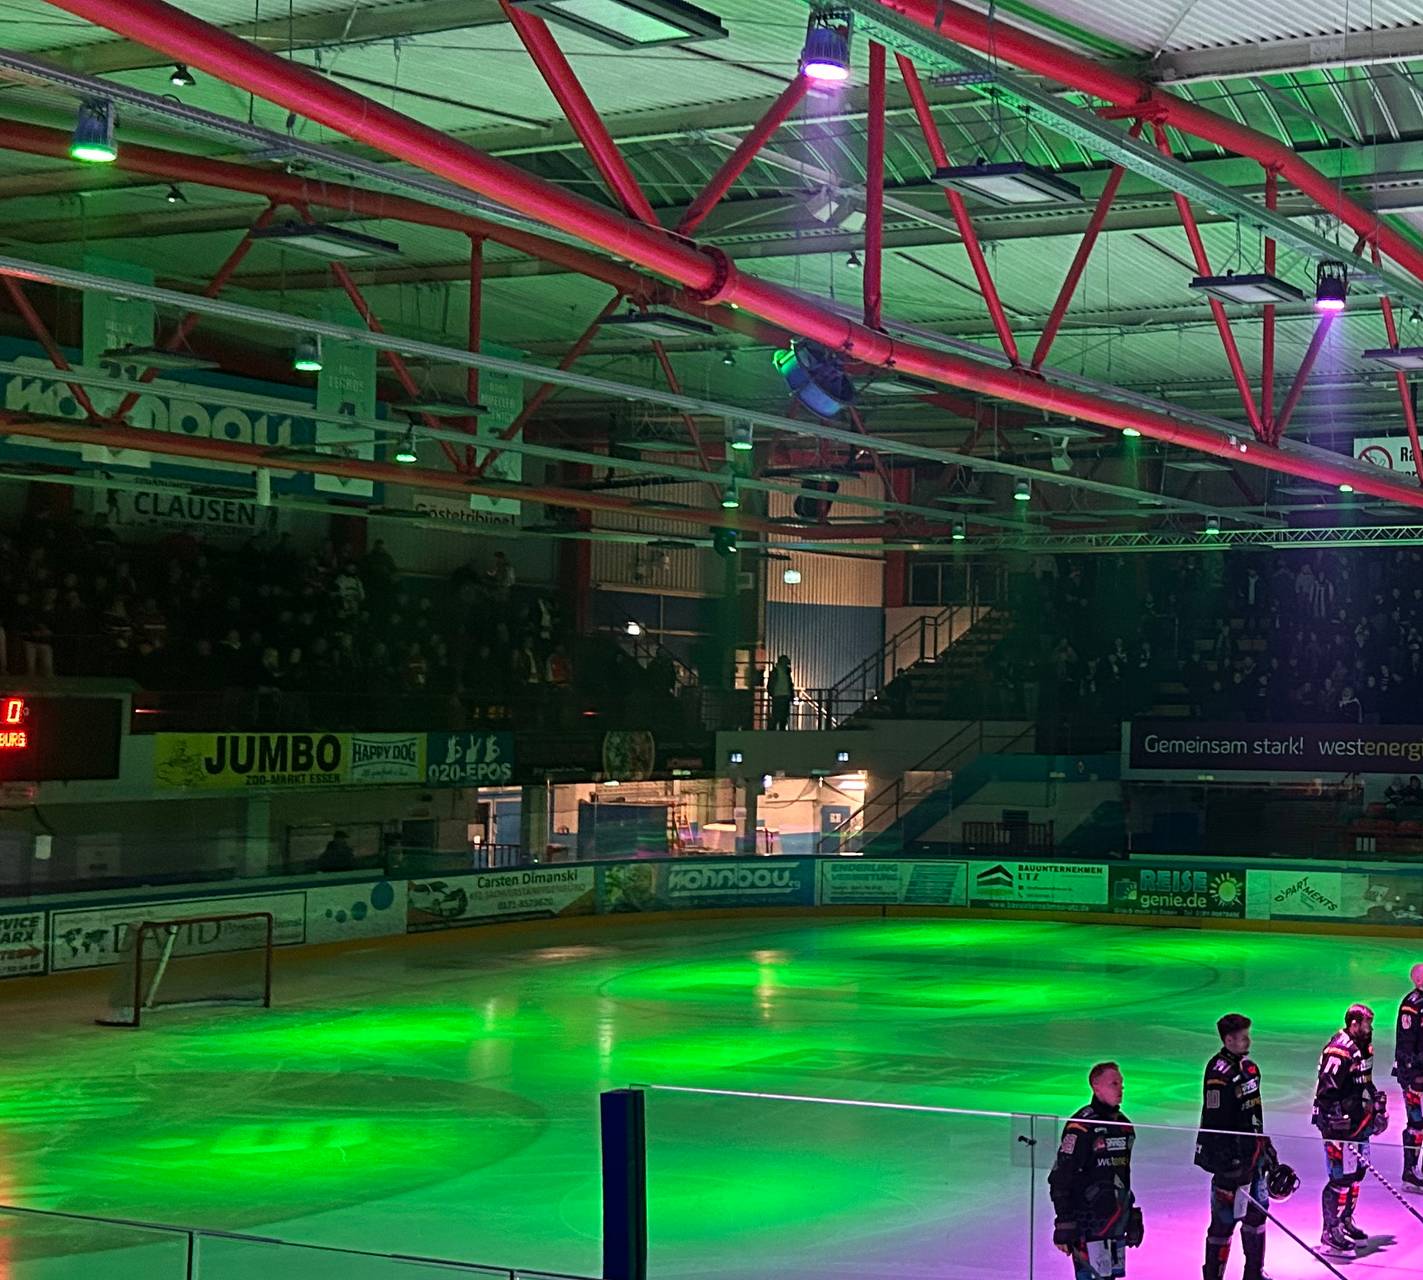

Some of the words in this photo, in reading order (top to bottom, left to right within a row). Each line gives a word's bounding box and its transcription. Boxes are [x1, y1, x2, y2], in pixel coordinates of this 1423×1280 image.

[5, 376, 292, 445] wonbau
[134, 492, 256, 525] CLAUSEN
[204, 734, 341, 775] JUMBO
[353, 742, 391, 763] HAPPY
[392, 742, 416, 761] DOG
[1144, 735, 1248, 755] Gemeinsam
[1253, 736, 1304, 756] stark!
[477, 874, 519, 890] Carsten
[522, 870, 578, 885] Dimanski
[668, 864, 791, 890] wohnbau
[1140, 869, 1208, 893] REISE
[1140, 893, 1208, 908] genie.de
[0, 916, 40, 930] VICE
